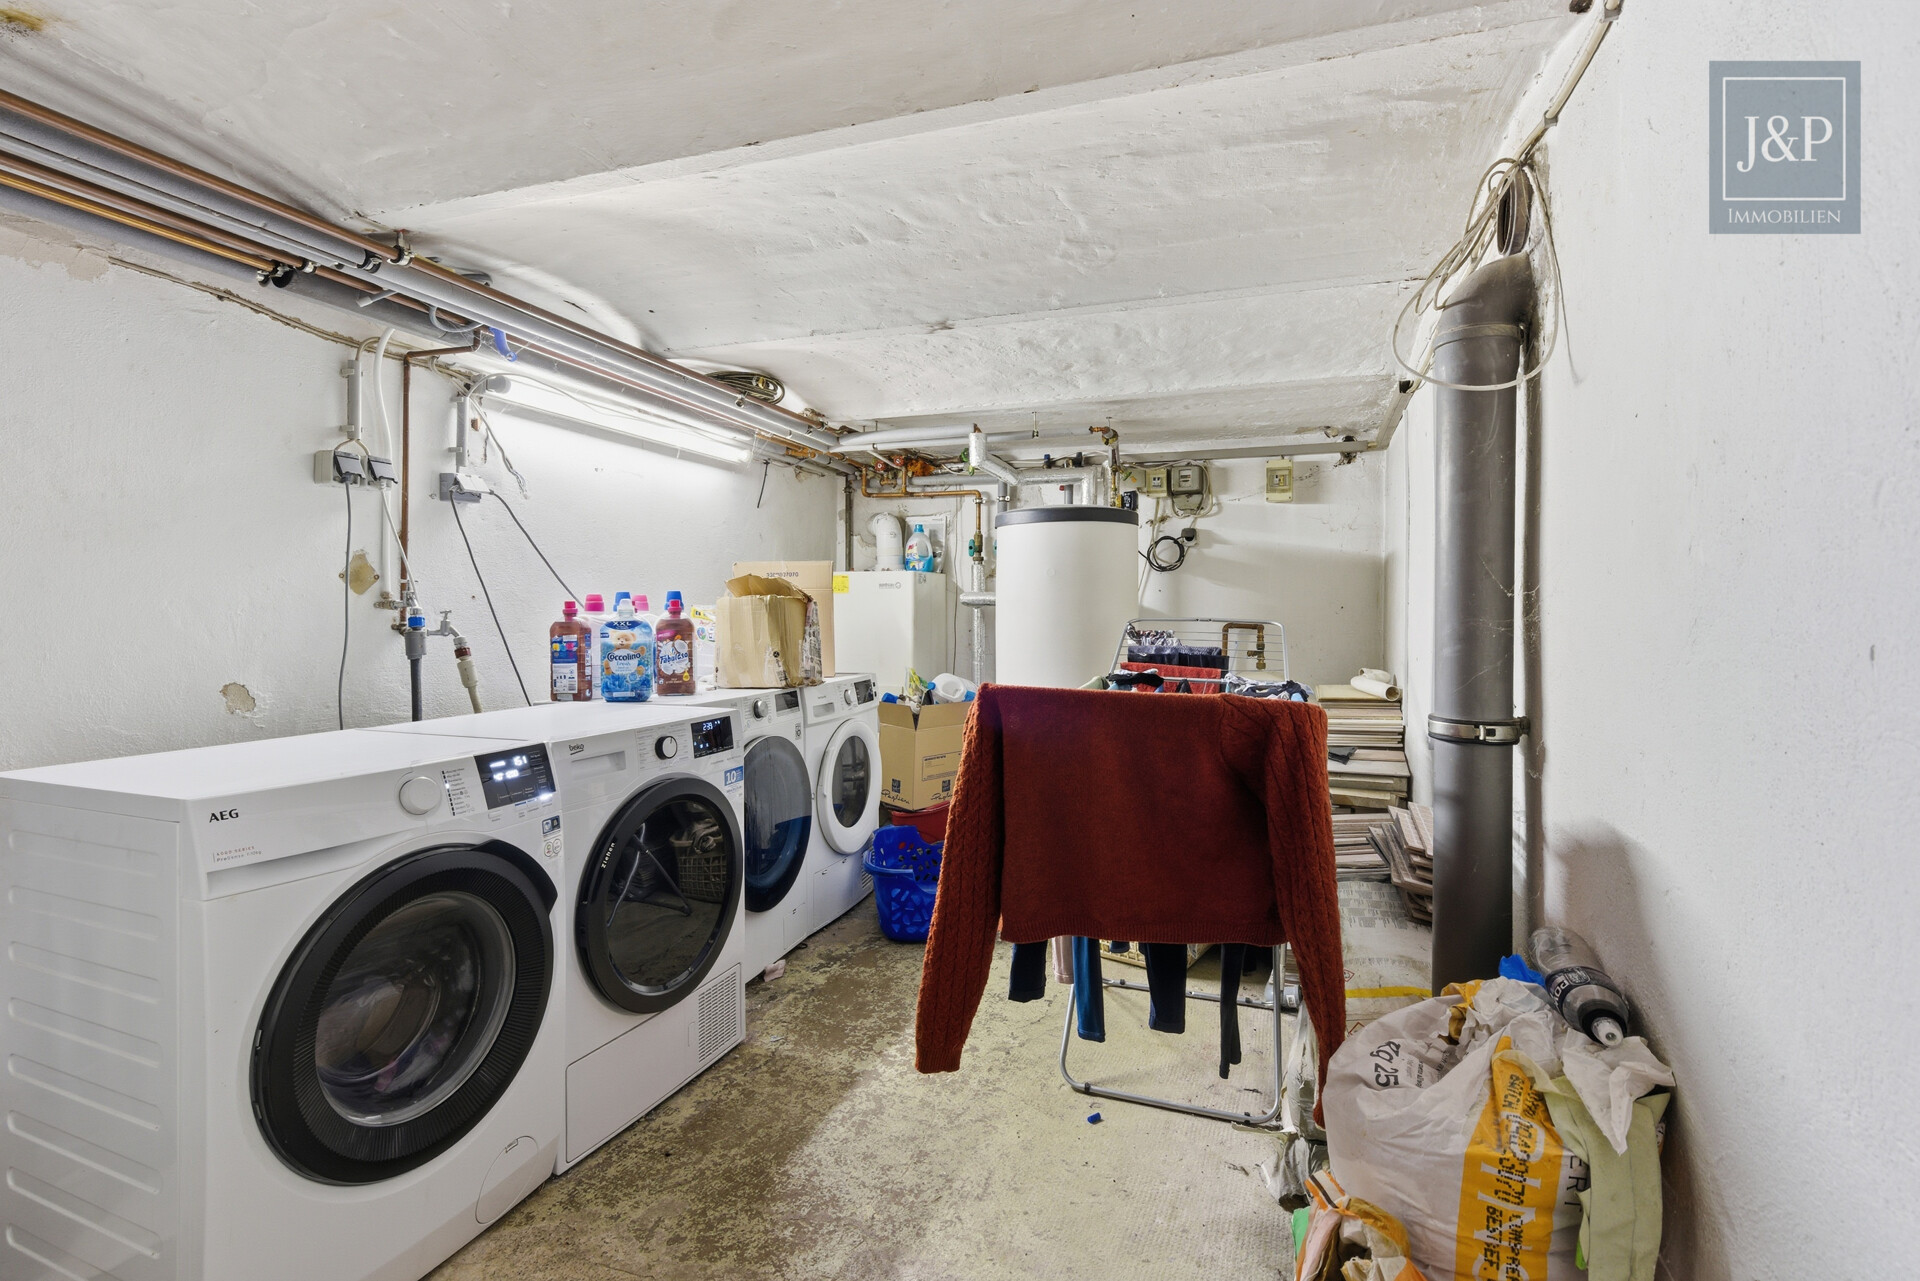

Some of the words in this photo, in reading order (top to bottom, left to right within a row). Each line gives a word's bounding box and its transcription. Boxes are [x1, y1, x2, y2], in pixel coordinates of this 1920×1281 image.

[606, 652, 641, 662] Coccolino
[568, 743, 585, 752] beko
[725, 770, 737, 785] 10
[208, 808, 239, 823] AEG
[600, 841, 616, 869] Ziehen
[1373, 1062, 1400, 1088] 25
[1501, 1073, 1526, 1109] BATCH
